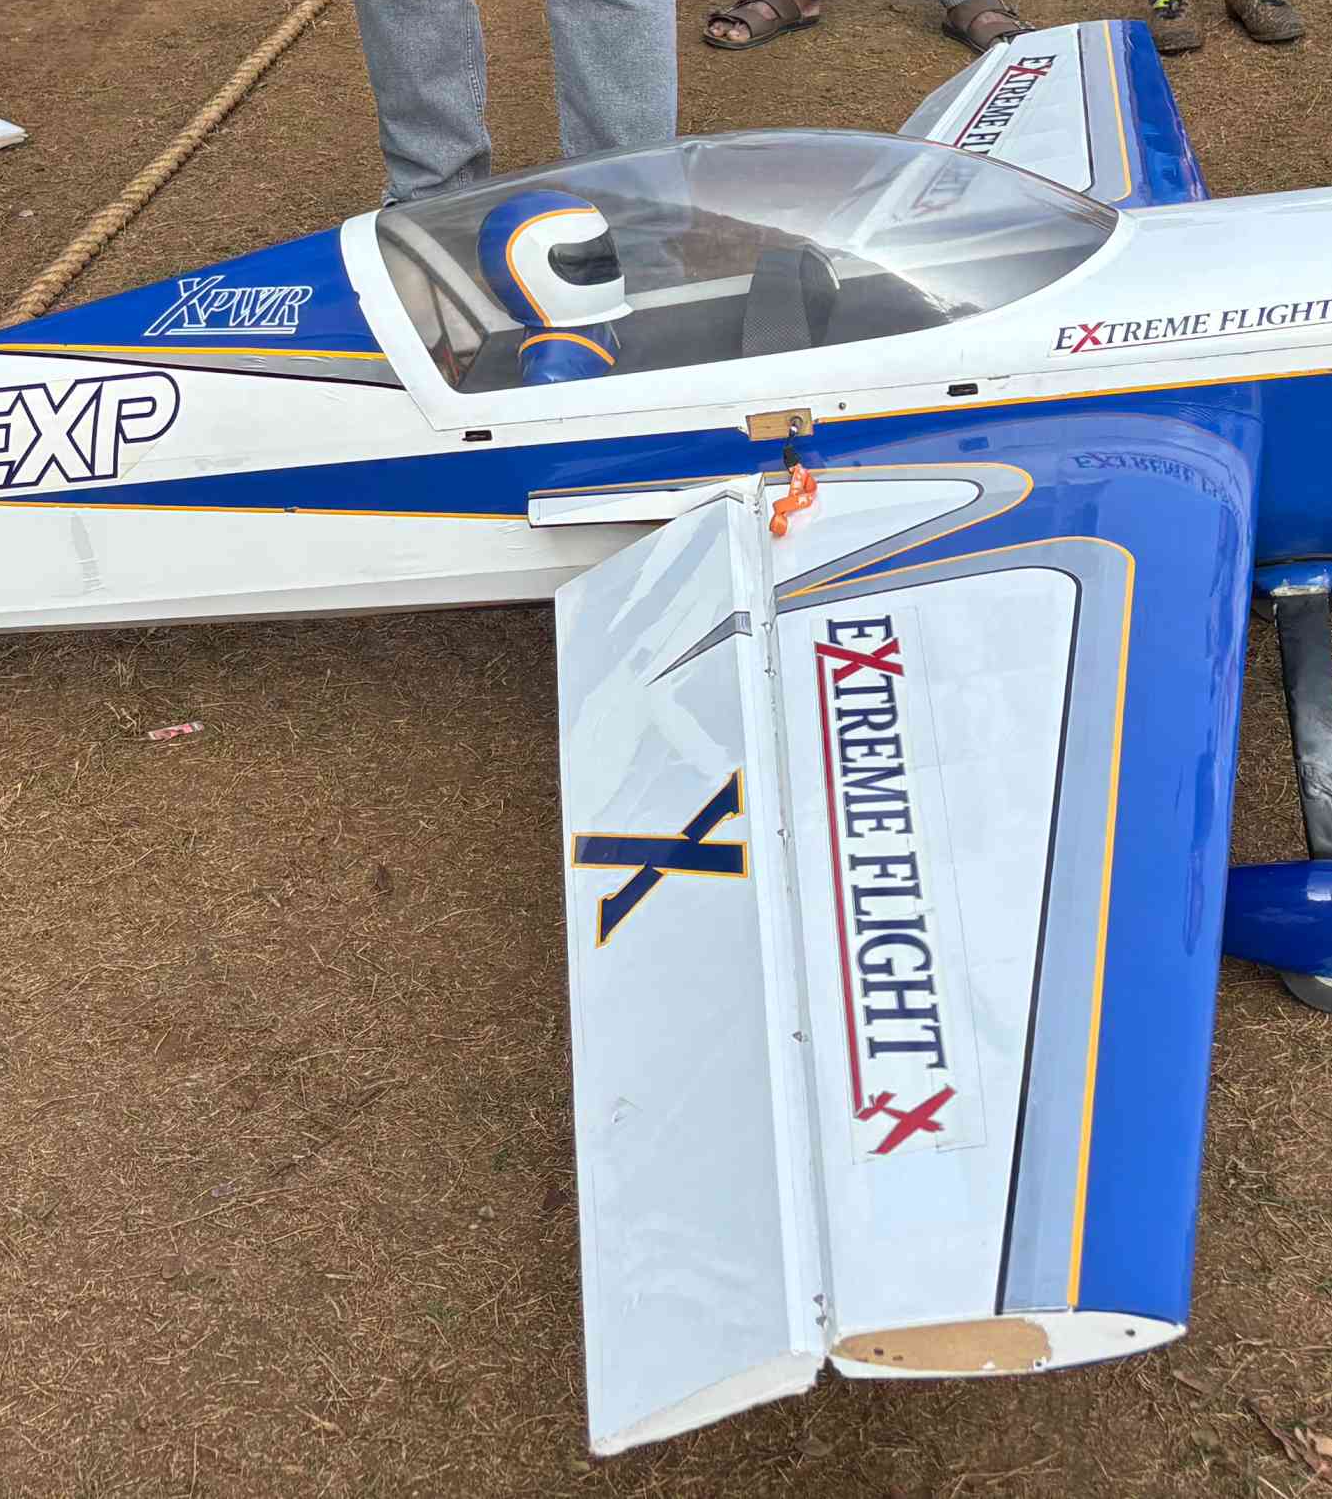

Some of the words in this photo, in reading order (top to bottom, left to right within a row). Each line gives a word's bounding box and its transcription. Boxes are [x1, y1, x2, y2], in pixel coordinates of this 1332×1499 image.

[971, 54, 1058, 130] EXTREME
[143, 275, 313, 336] XPWR
[1052, 313, 1211, 354] EXTREME
[814, 615, 914, 838] EXTREME
[848, 851, 948, 1069] FLIGHT
